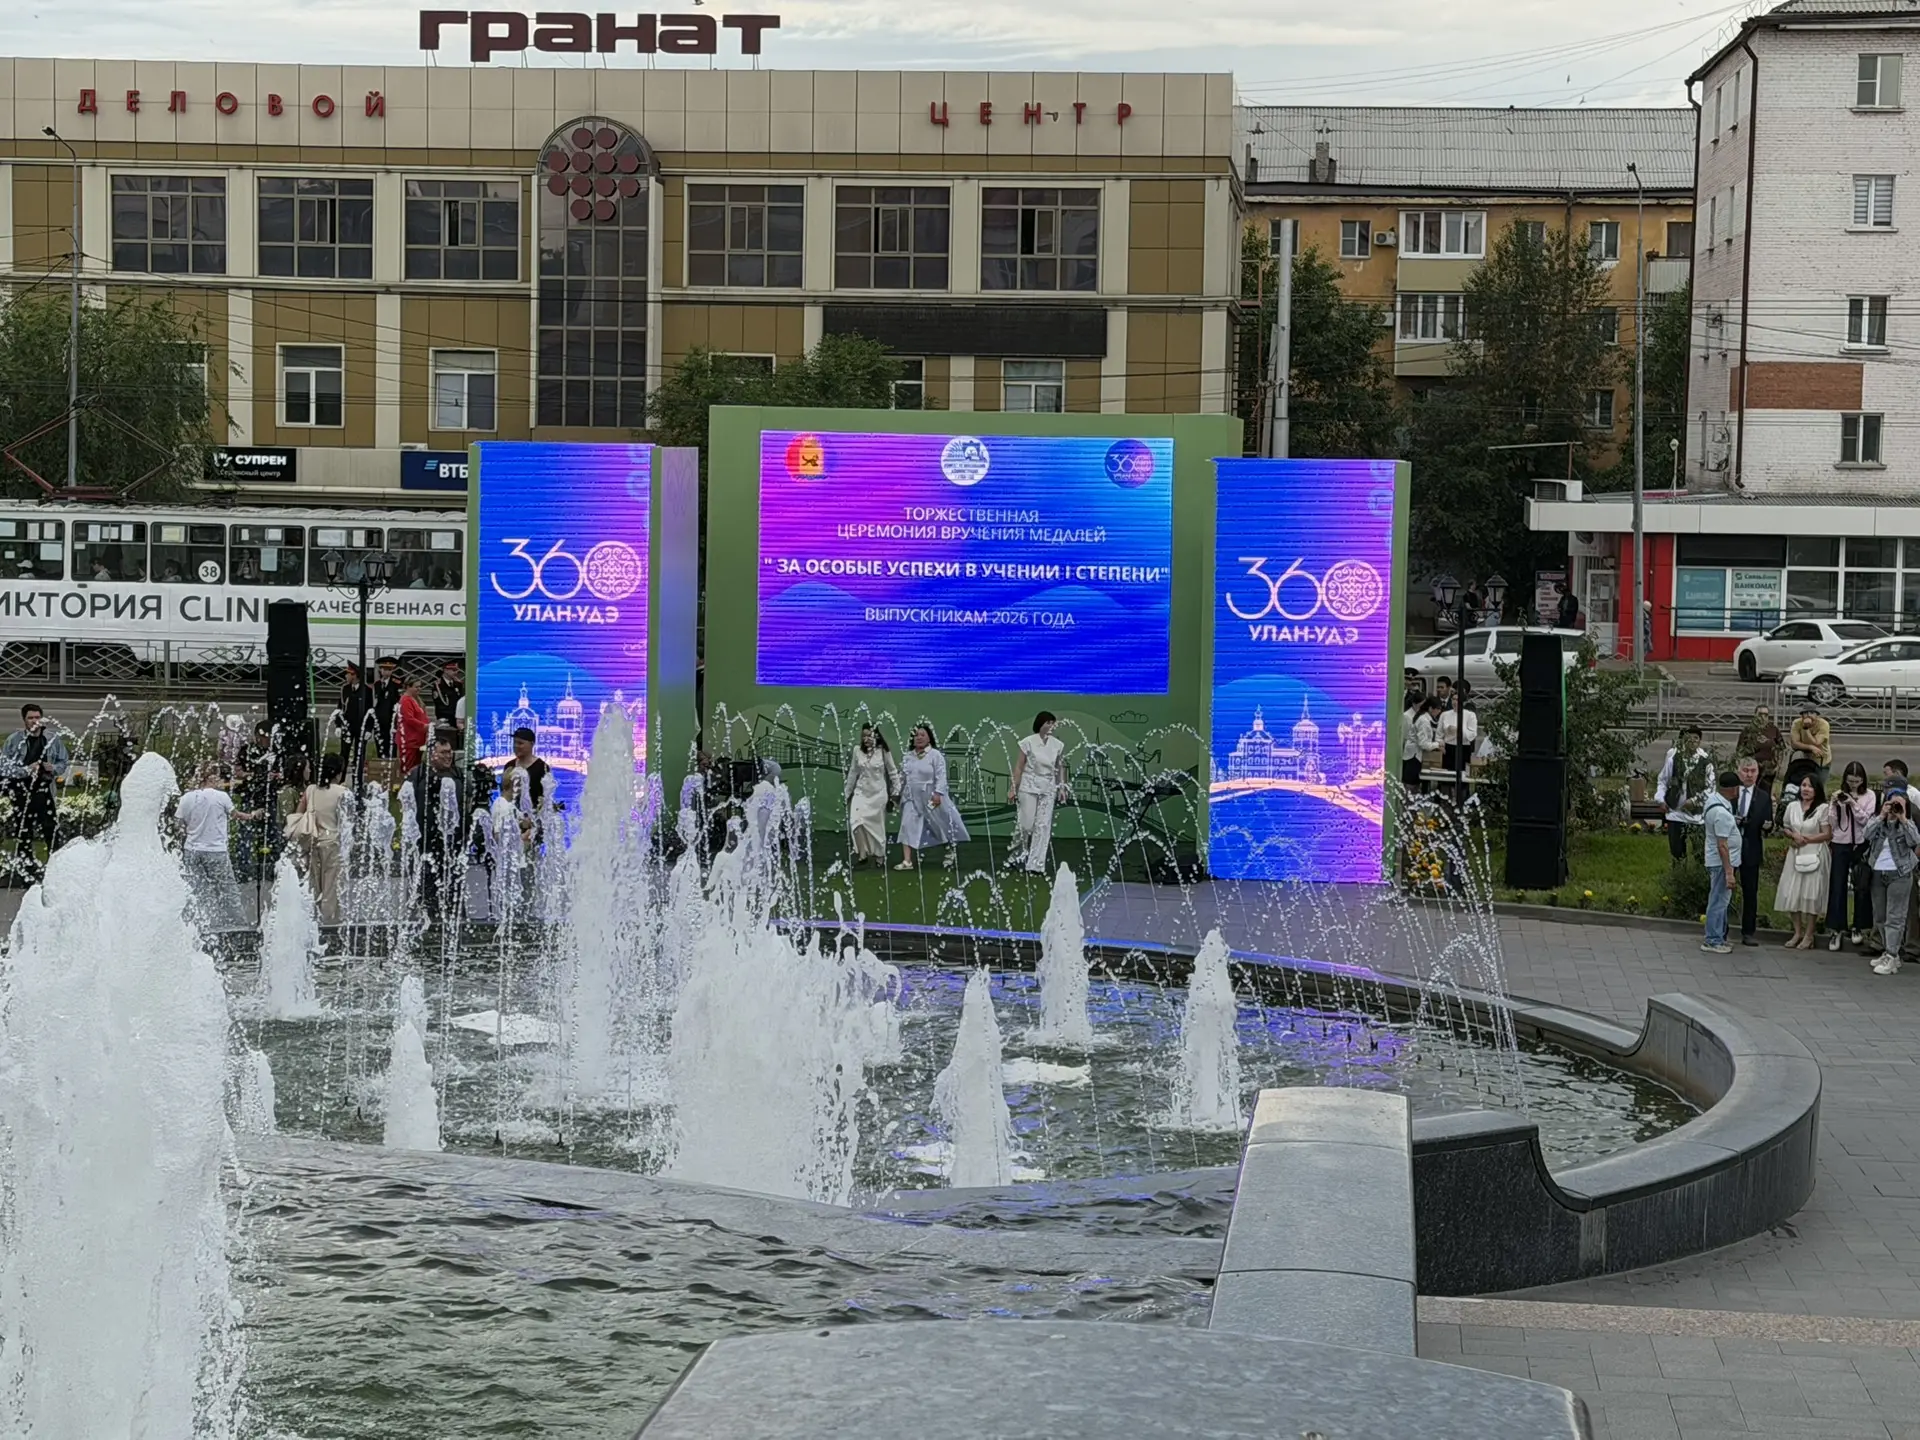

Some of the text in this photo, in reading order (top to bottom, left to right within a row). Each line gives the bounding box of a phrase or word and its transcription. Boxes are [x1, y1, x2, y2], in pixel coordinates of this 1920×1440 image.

[77, 89, 1132, 128] ДЕЛОВОЙ ЦЕНТР
[235, 455, 287, 465] СУПРЕН
[439, 463, 468, 479] ВТБ
[904, 507, 1040, 523] ТОРЖЕСТВЕННАЯ
[837, 524, 1107, 545] ЦЕРЕМОНИЯ ВРУЧЕНИЯ МЕДАЛЕЙ
[201, 566, 218, 578] 38
[776, 558, 801, 574] ЗА
[805, 558, 883, 576] ОСОБЫЕ
[886, 560, 960, 578] УСПЕХИ
[965, 563, 977, 577] В
[981, 563, 1060, 580] УЧЕНИИ
[1075, 565, 1168, 582] СТЕПЕНИ"
[1734, 582, 1777, 590] БАНКОМАТ
[180, 596, 293, 623] CLINI
[305, 600, 444, 616] КАЧЕСТВЕННАЯ
[513, 604, 620, 625] УЛАН-УДЭ
[865, 607, 1076, 628] ВЫПУСКНИКАМ 2026 ГОДА
[1249, 624, 1360, 646] УЛАН-УДЭ
